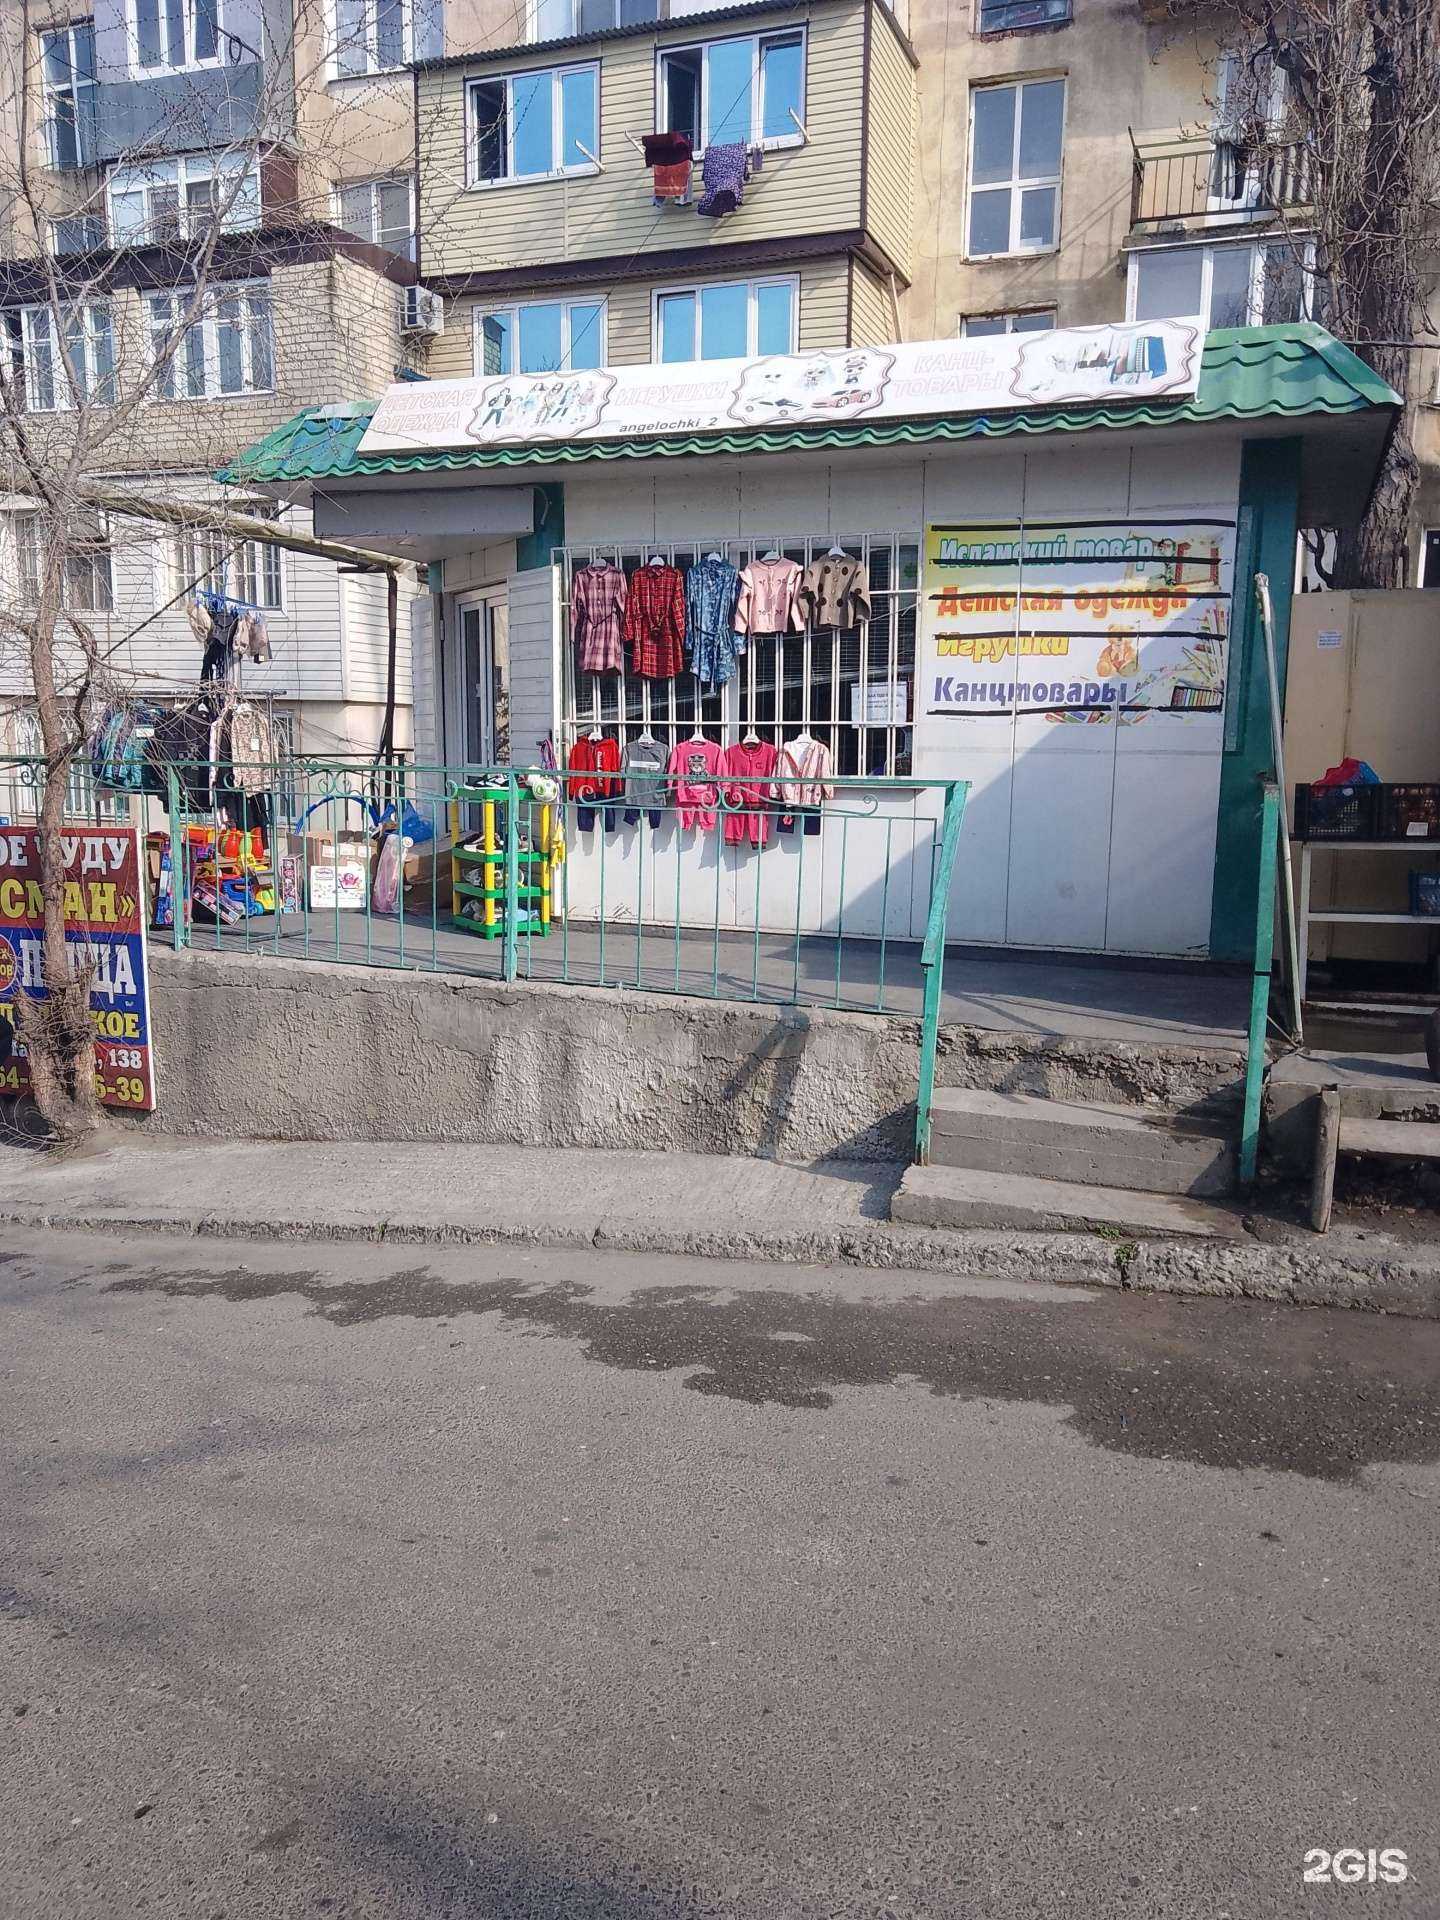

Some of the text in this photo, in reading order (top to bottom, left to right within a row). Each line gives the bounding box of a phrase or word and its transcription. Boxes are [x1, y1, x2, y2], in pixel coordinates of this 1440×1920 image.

[913, 351, 994, 373] КАНЦ-
[615, 381, 728, 406] ИГРУШКИ
[893, 371, 1004, 399] ТОВАРЫ
[384, 389, 477, 413] ДЕТСКАЯ
[376, 411, 460, 433] ОДЕЖДА
[619, 417, 718, 433] angelochki_2
[939, 534, 1067, 568] Исламский
[937, 586, 1188, 618] Детская одежда
[937, 632, 1070, 663] Игрушки
[934, 677, 1128, 706] Канцтовары
[108, 1048, 143, 1069] 138
